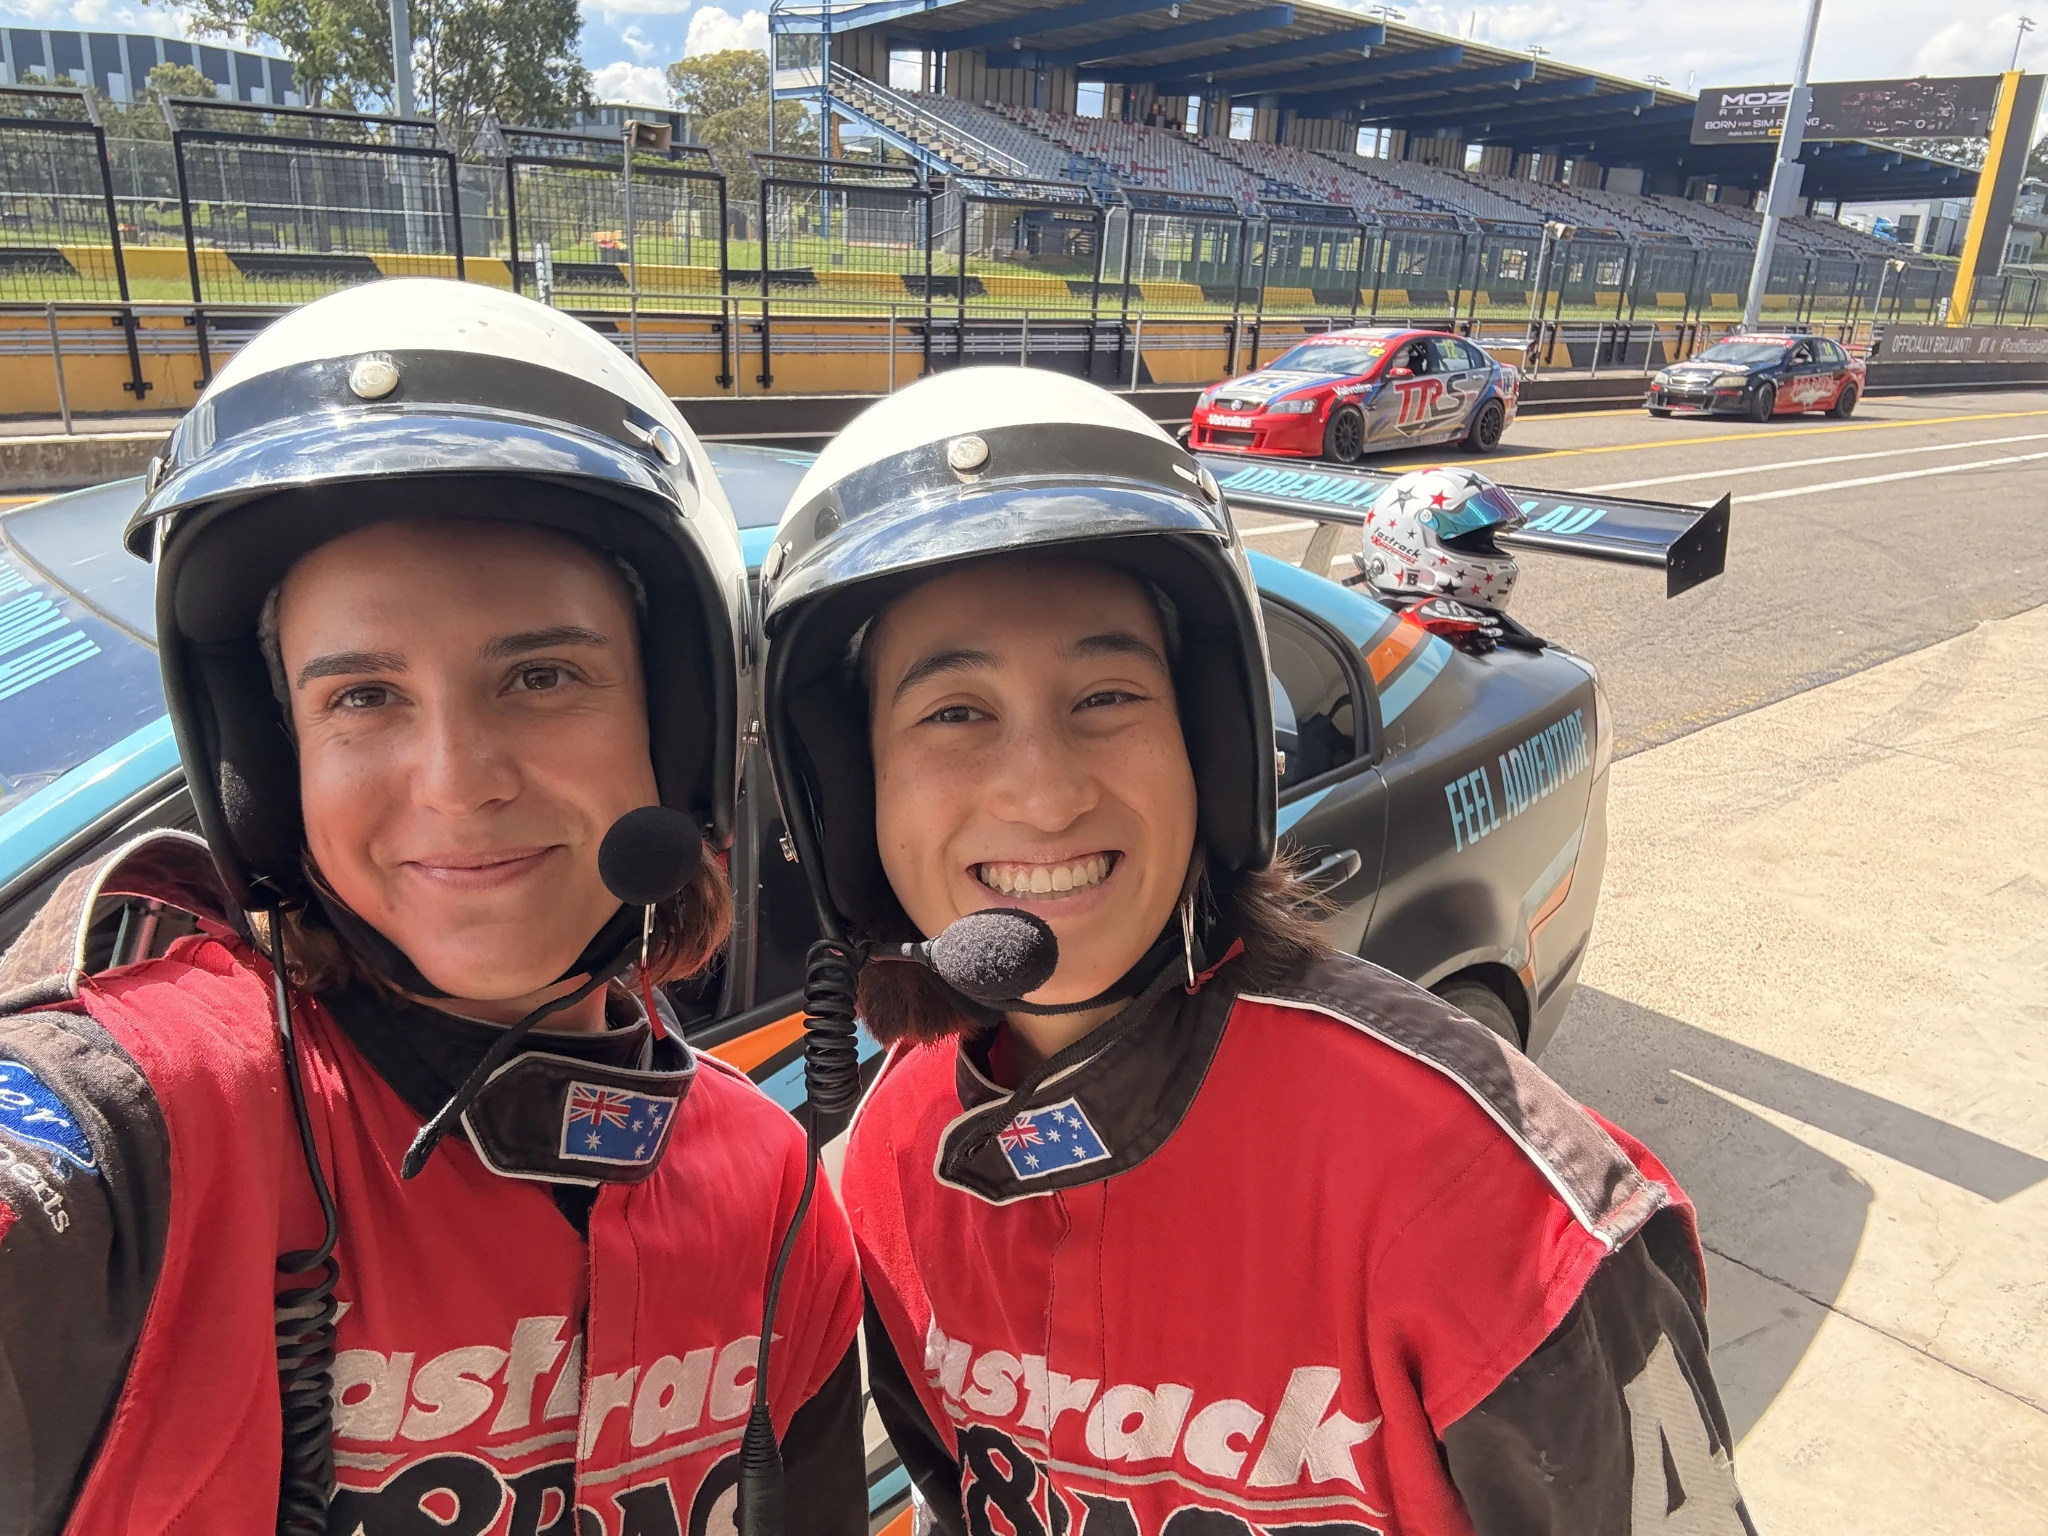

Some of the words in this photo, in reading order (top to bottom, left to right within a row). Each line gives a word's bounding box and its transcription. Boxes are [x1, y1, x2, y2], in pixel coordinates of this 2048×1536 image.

[1721, 91, 1813, 107] MOZ
[1705, 120, 1737, 130] BORN
[1753, 119, 1774, 129] SIM
[1310, 338, 1386, 347] HOLDEN
[1729, 337, 1788, 345] HOLDEN
[1892, 335, 1935, 354] OFFICIALLY
[1932, 336, 1973, 354] BRILLIANT!
[1332, 383, 1374, 397] Valvoline
[1208, 413, 1253, 428] Valvoline
[1219, 466, 1390, 508] ADRENALI
[1374, 527, 1422, 559] fastrack
[1444, 765, 1501, 853] FEEL
[1498, 707, 1591, 822] ADVENTURE
